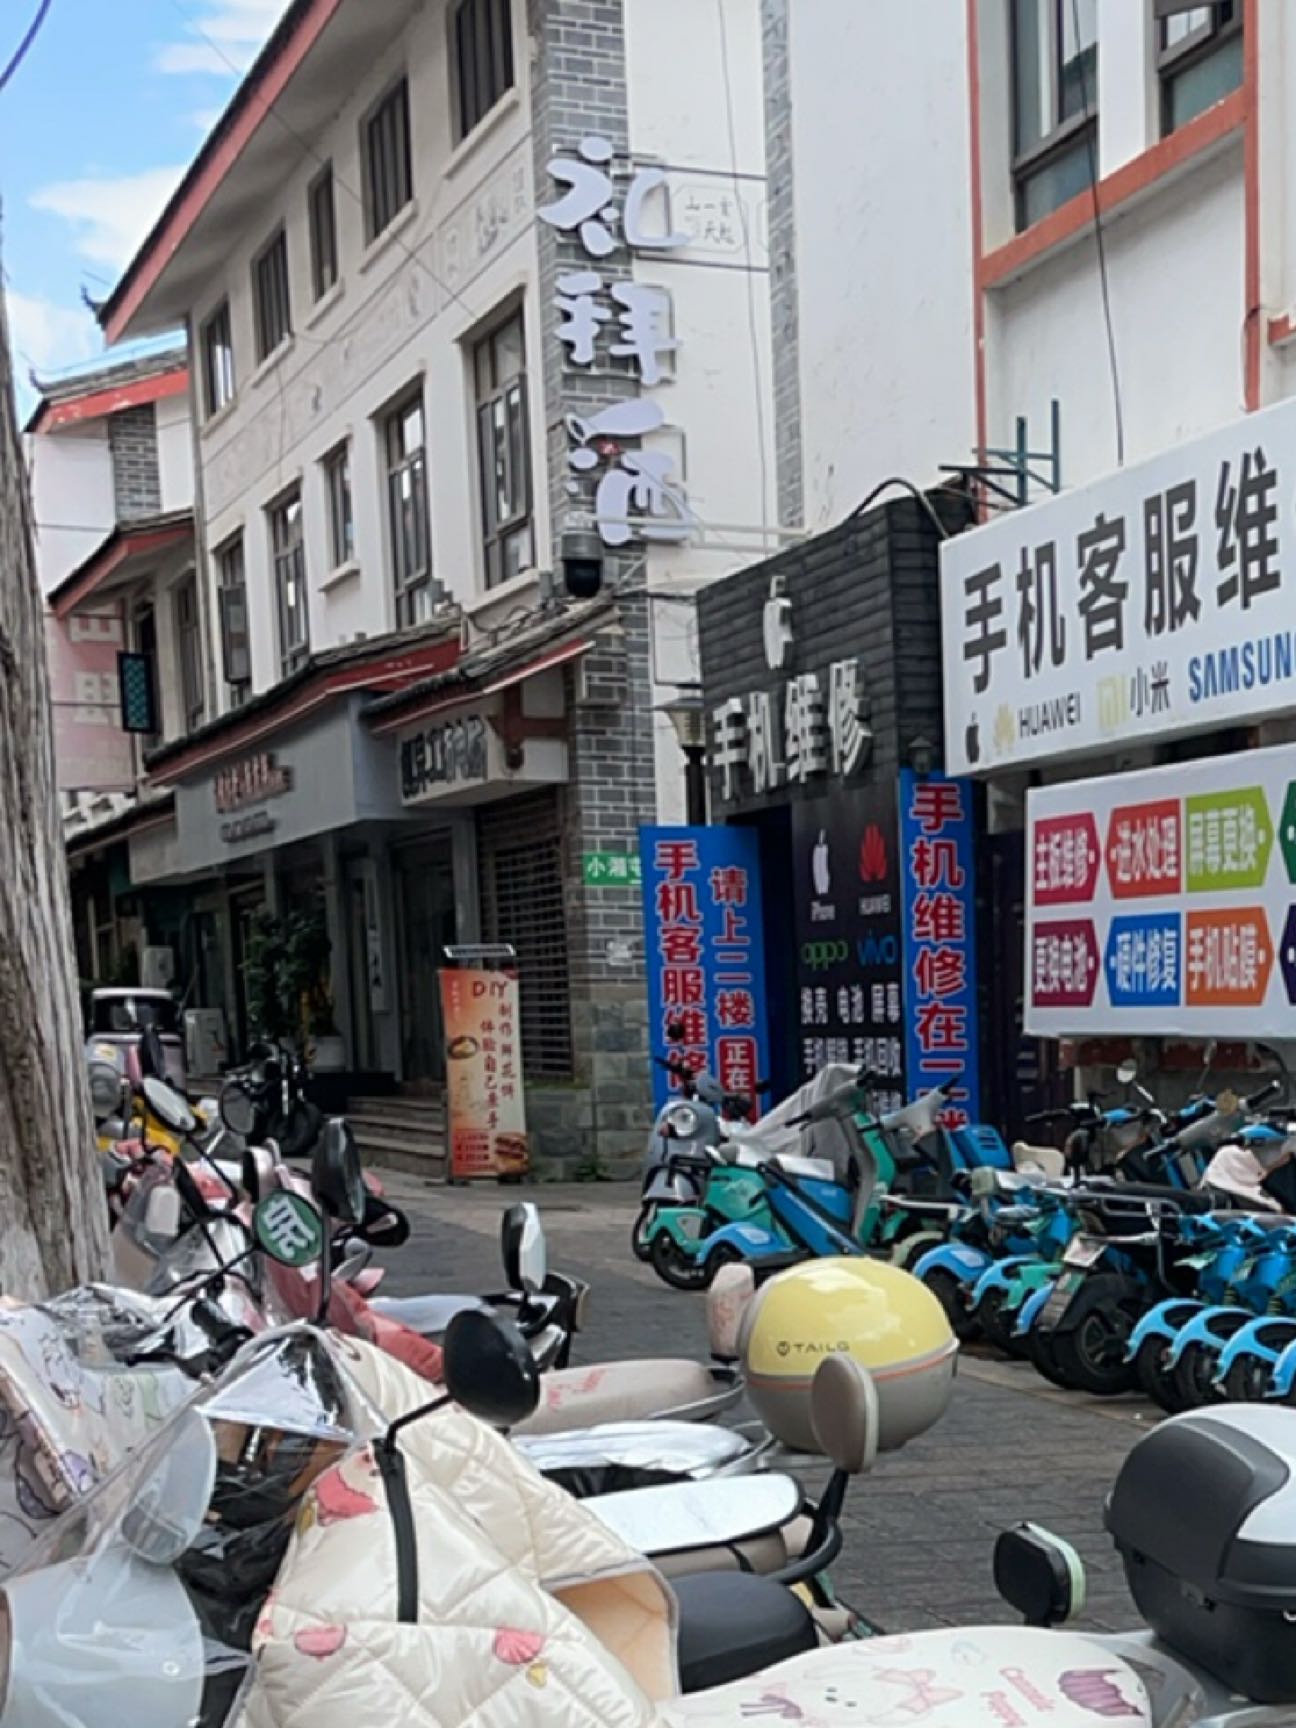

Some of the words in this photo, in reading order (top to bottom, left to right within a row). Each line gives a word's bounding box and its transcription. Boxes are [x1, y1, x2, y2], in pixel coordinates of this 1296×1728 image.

[1018, 691, 1081, 739] HUAWEI
[1130, 661, 1170, 717] 小米
[712, 657, 872, 800] 手机维修
[1036, 827, 1088, 890] 主板维修
[1189, 803, 1257, 876] 屏幕更换
[711, 865, 754, 1028] 请上二楼
[1035, 933, 1087, 993] 更换电池
[1189, 923, 1258, 990] 手机贴膜
[472, 980, 508, 998] DIY
[792, 1341, 850, 1354] TAILG
